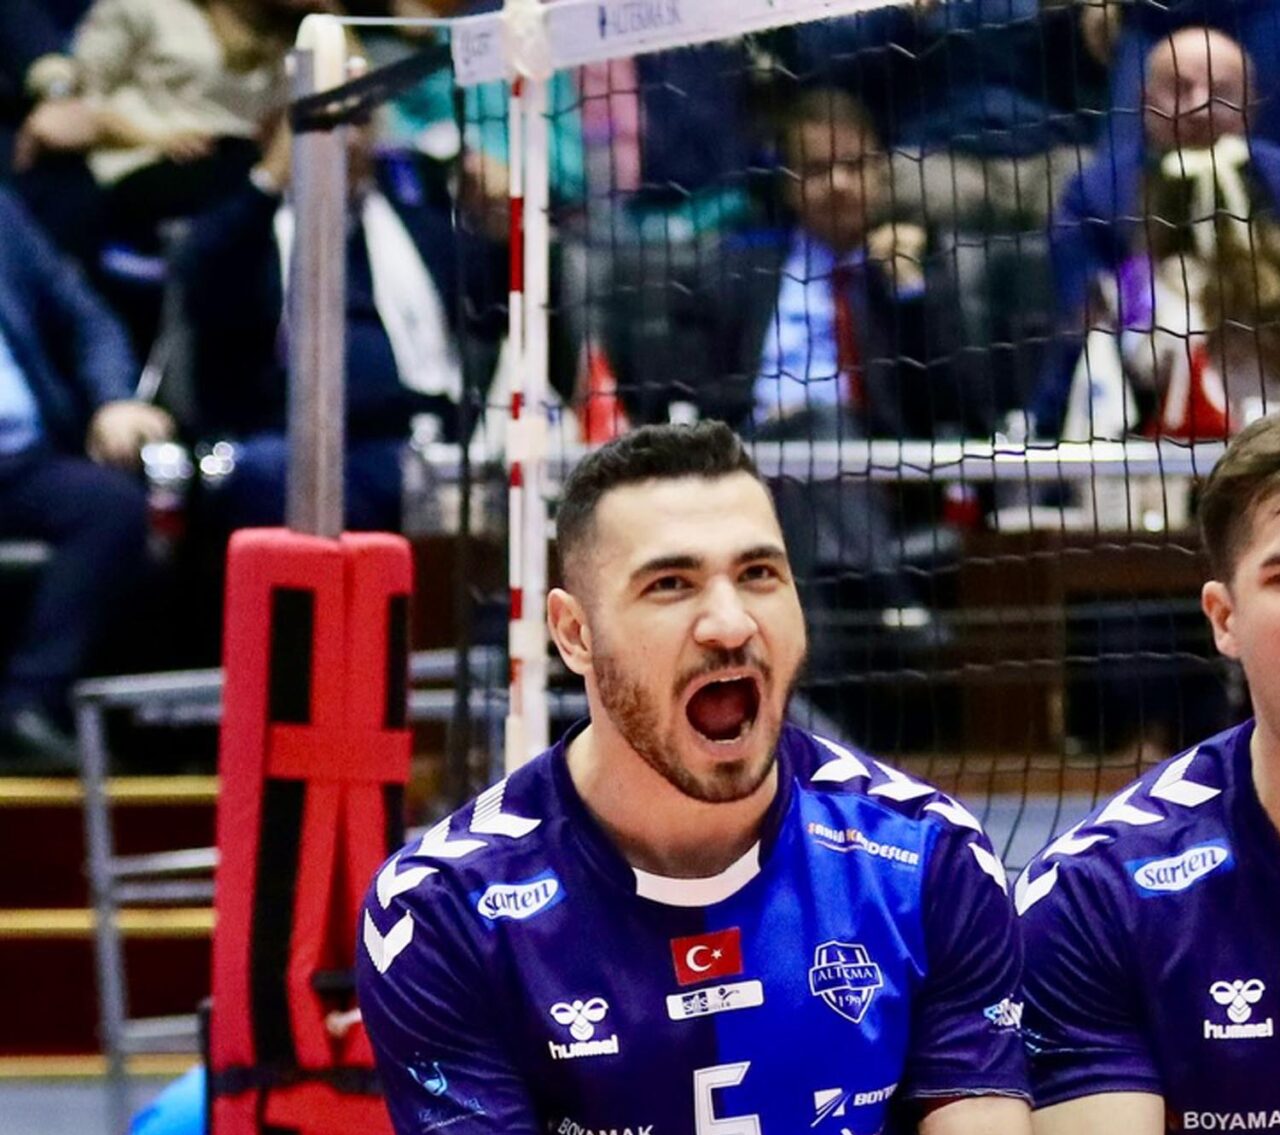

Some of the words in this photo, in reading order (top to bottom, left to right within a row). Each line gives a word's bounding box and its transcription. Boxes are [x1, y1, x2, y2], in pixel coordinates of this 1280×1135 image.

[1143, 848, 1218, 888] sarten
[483, 882, 550, 917] sarten
[1203, 1017, 1274, 1039] hummel
[548, 1034, 619, 1060] hummel
